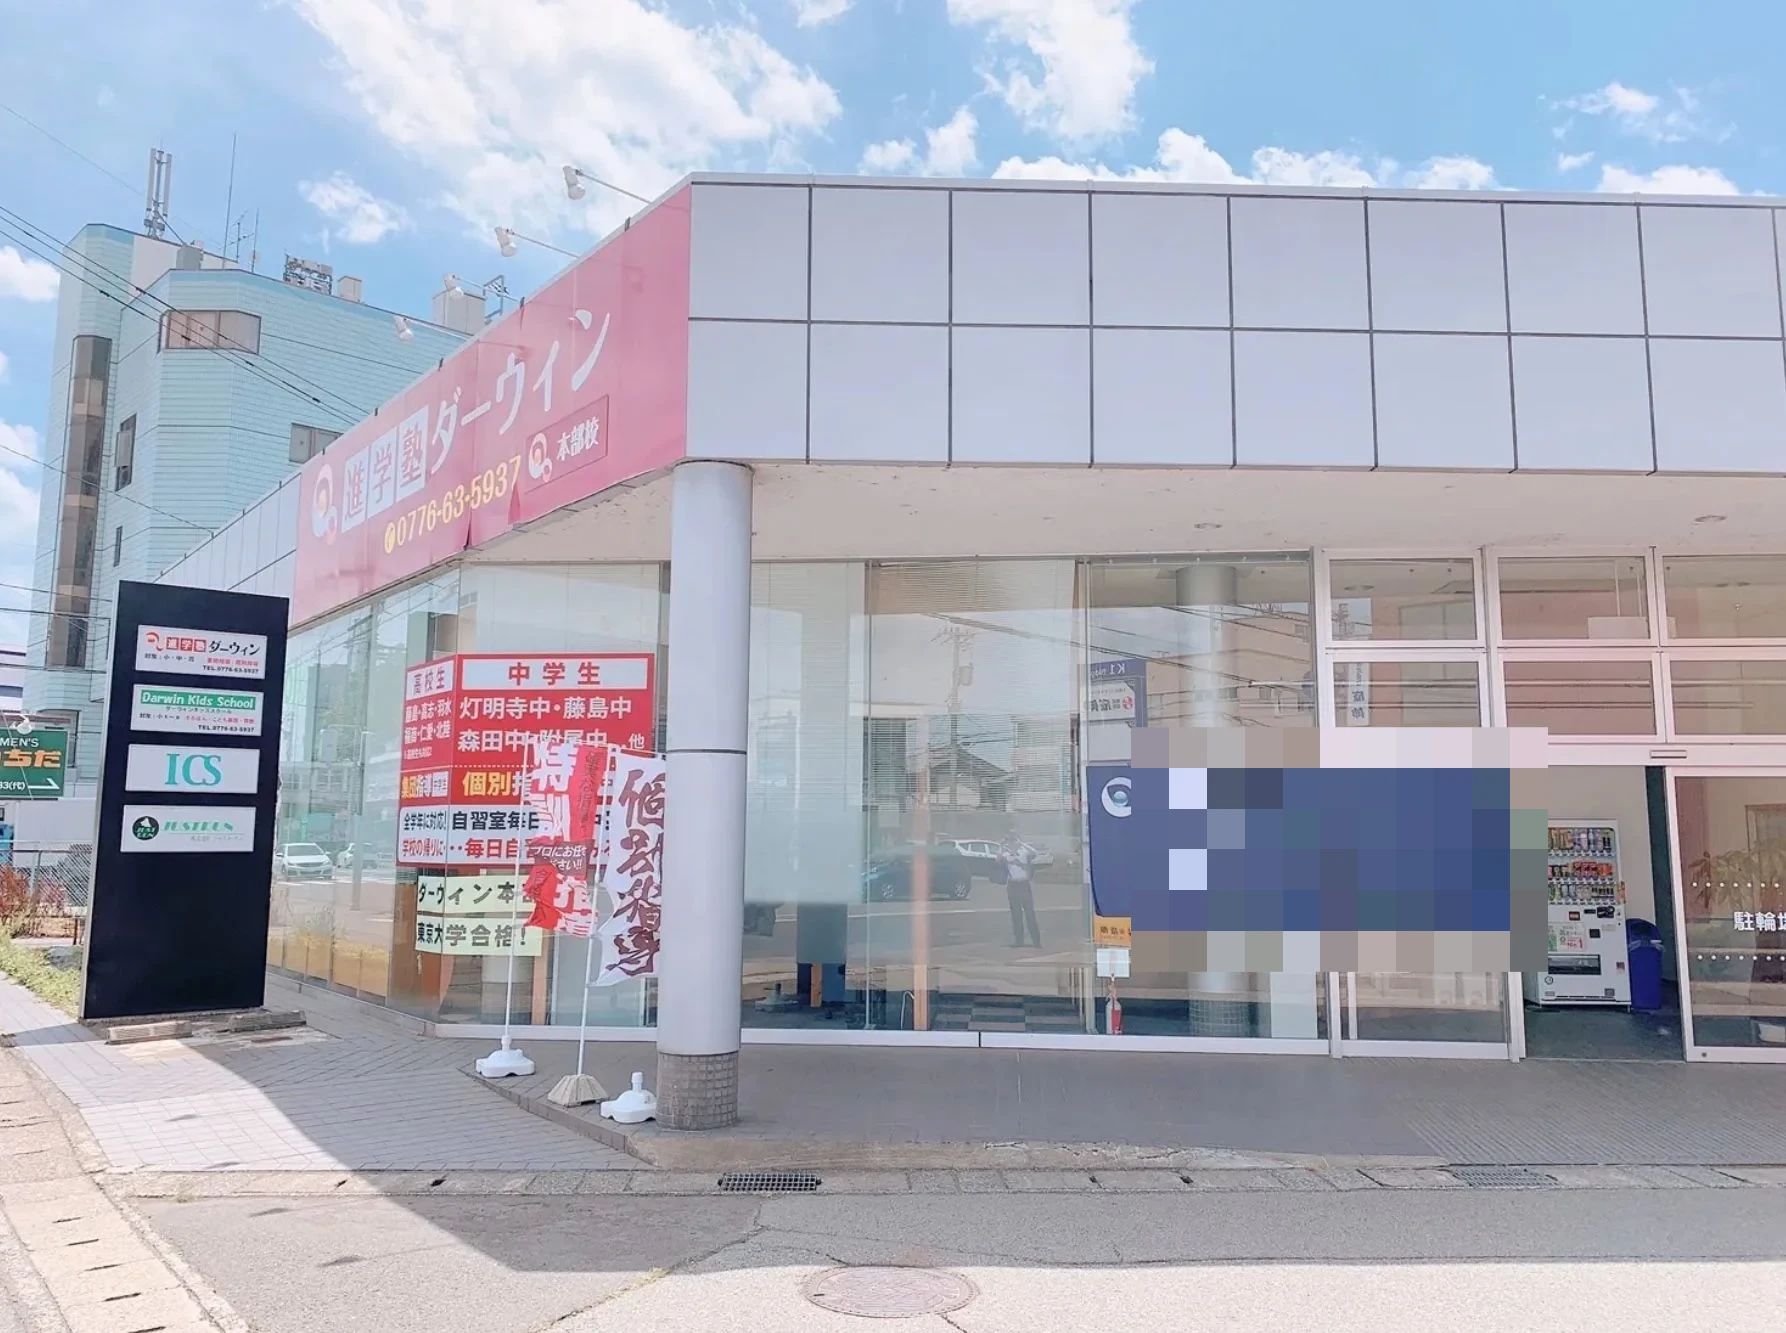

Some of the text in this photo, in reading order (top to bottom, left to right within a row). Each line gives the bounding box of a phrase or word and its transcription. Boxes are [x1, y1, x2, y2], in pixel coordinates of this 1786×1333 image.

[344, 308, 611, 522] 進学塾ダーウィン
[395, 456, 522, 547] 0776-63-5937
[508, 661, 601, 686] 中学生
[142, 692, 254, 708] Darwin Kids School
[459, 695, 632, 720] 灯明寺中・藤島中
[0, 749, 62, 768] ちだ
[165, 753, 222, 786] ICS
[417, 922, 527, 948] 東京大学合格!
